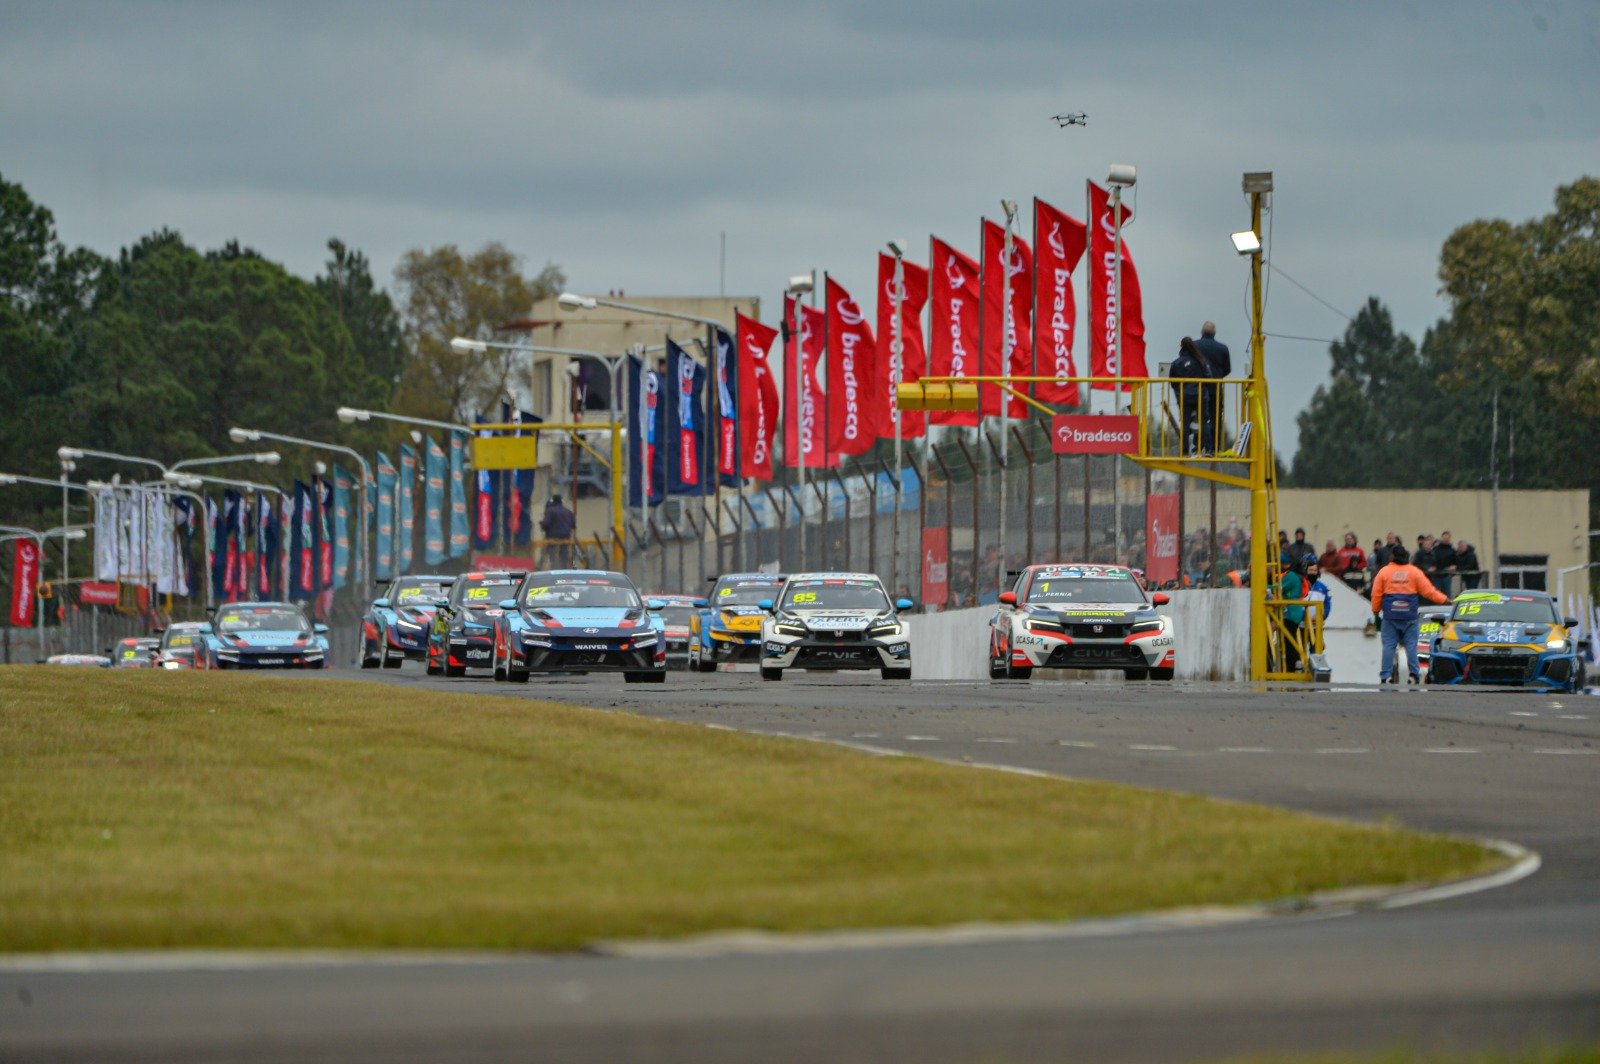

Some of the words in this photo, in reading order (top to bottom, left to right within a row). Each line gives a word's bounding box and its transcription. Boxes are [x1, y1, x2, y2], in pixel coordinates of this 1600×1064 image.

[1052, 268, 1070, 387] bradesco
[950, 297, 967, 383] brades
[841, 332, 861, 440] bradesco
[1073, 428, 1132, 443] bradesco
[528, 586, 548, 599] 27
[1040, 582, 1050, 592] 1
[466, 588, 490, 599] 16
[793, 592, 817, 603] 85
[1458, 605, 1481, 616] 15
[1419, 622, 1440, 633] 88
[1487, 628, 1518, 636] CAR
[1015, 636, 1035, 645] OCASA
[1152, 638, 1170, 647] OCASA
[1487, 634, 1518, 643] ONE
[1072, 649, 1122, 657] CIVIC
